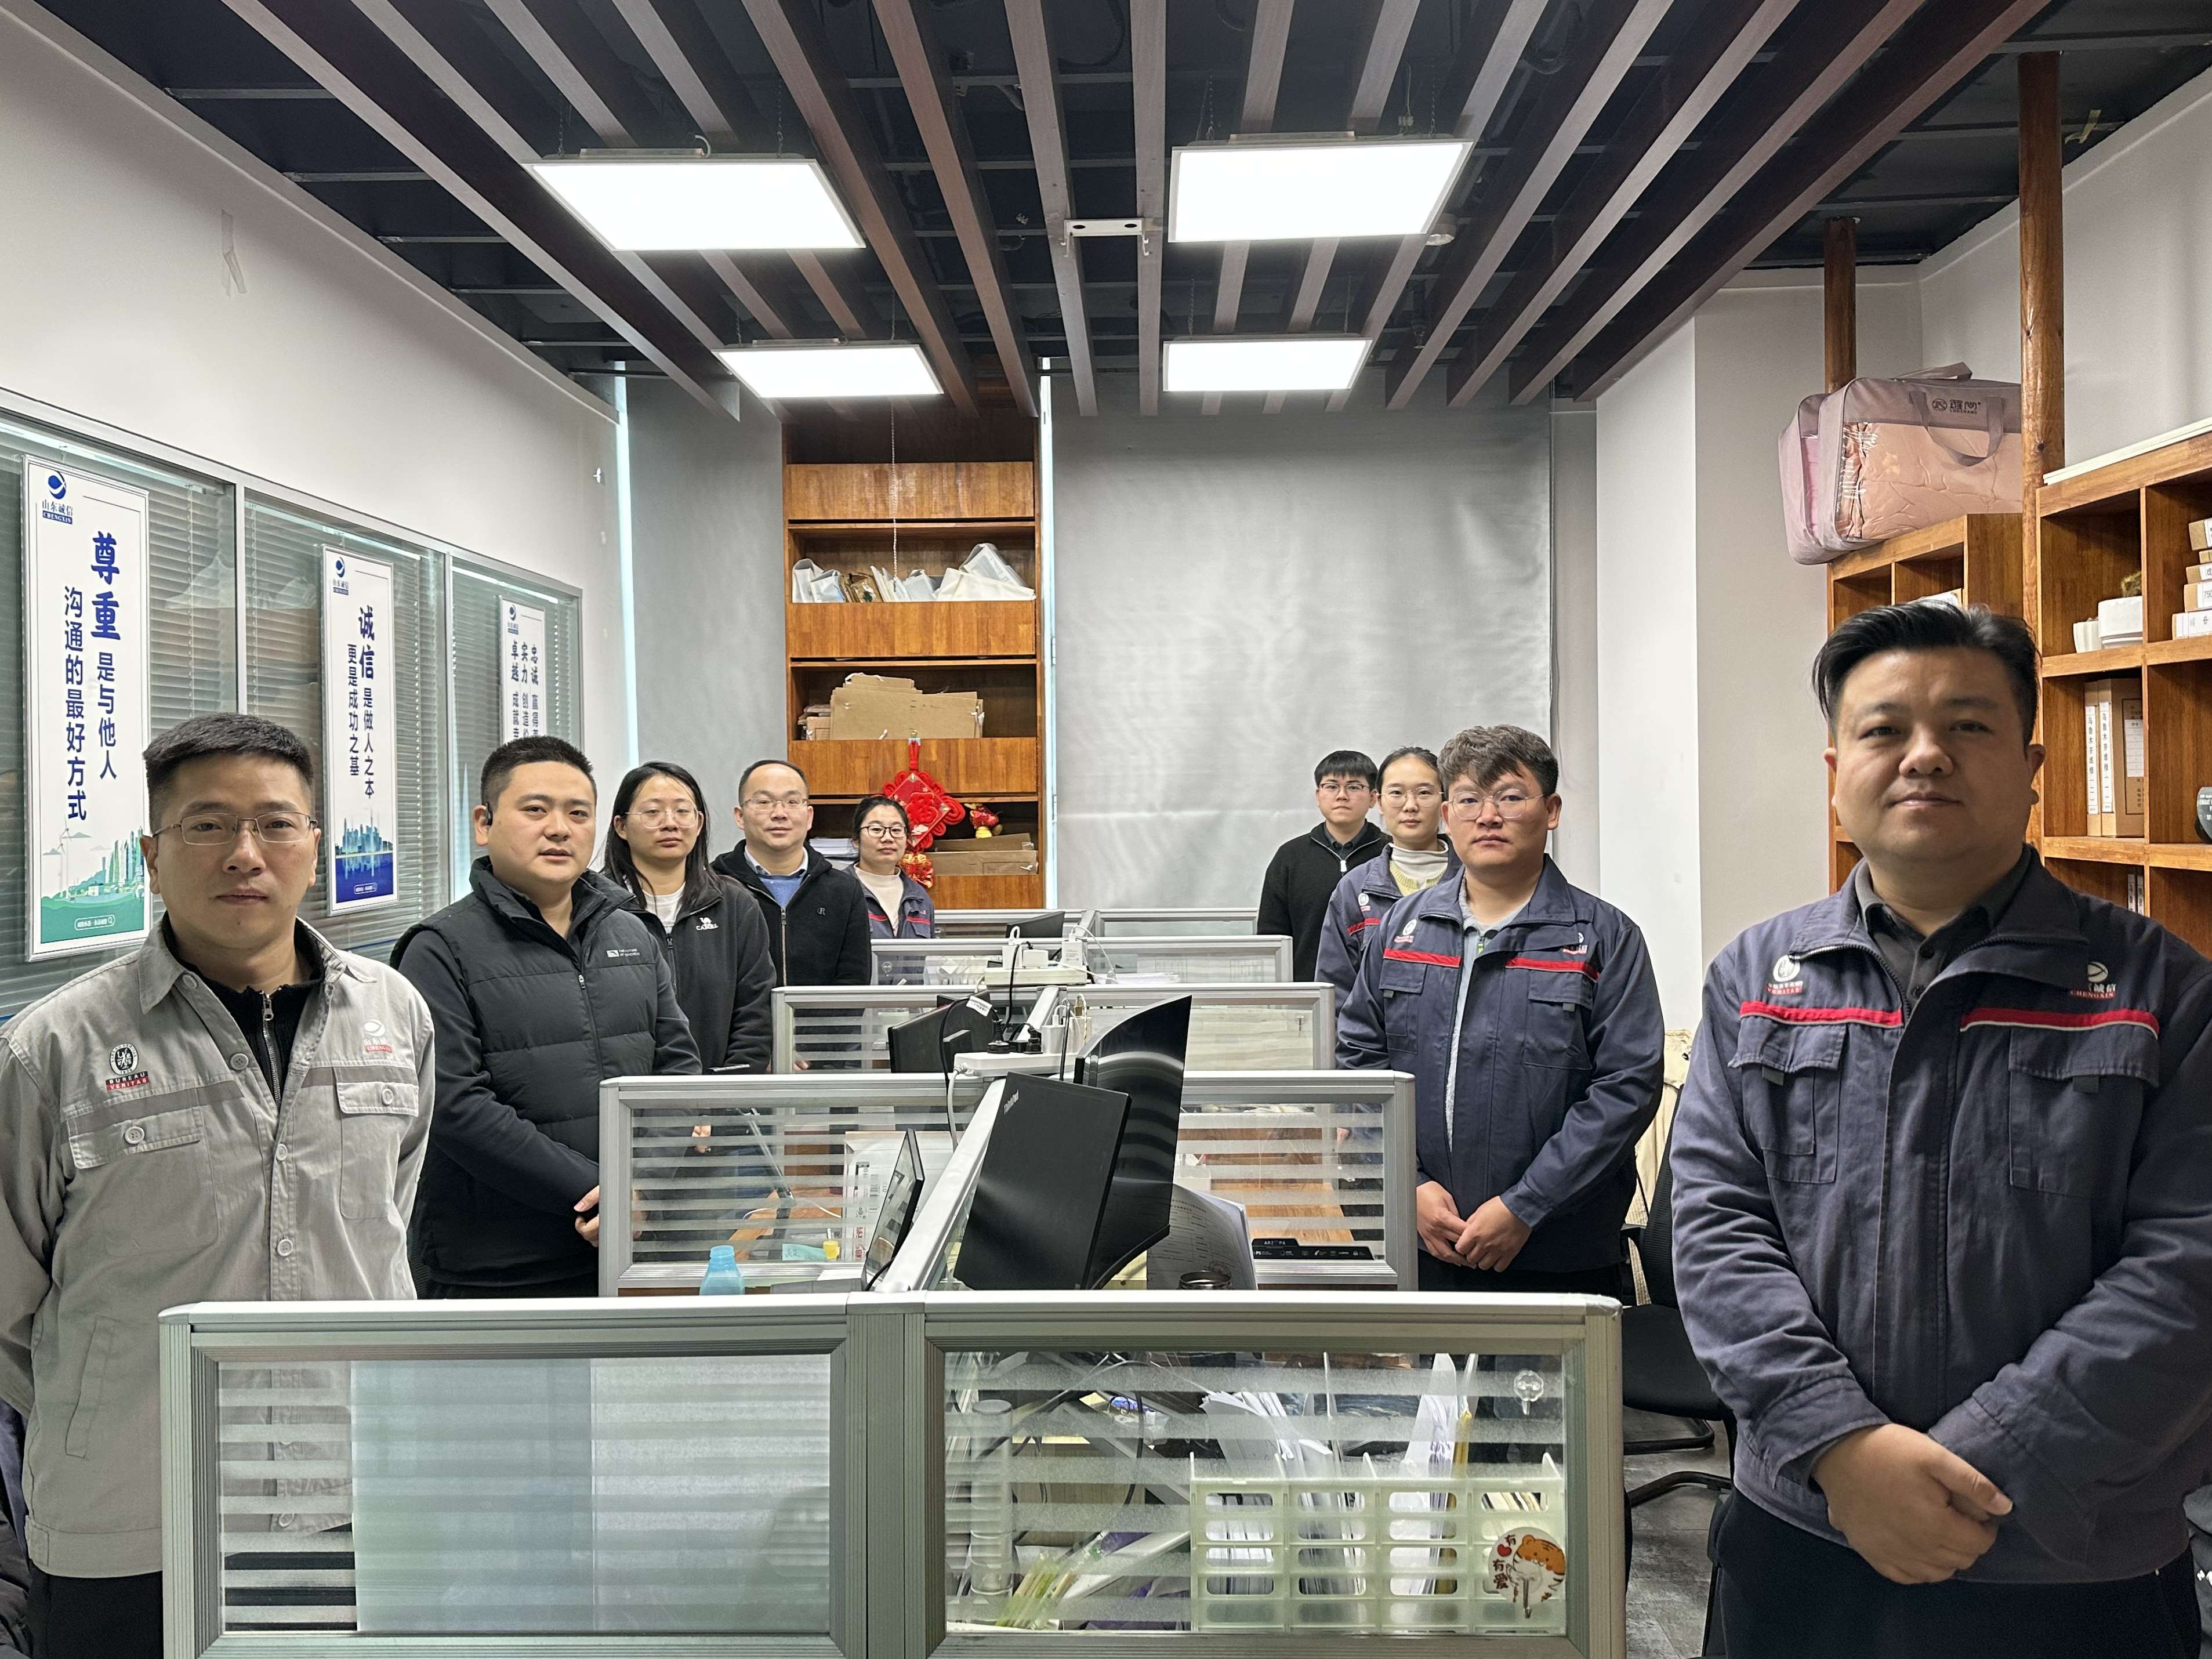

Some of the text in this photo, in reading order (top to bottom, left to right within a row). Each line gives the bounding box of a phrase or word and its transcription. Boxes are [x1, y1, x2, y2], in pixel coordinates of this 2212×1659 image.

[64, 585, 87, 821] 沟通的最好方式
[90, 530, 121, 780] 尊重 是与他人
[347, 643, 360, 776] 更是成功之基
[358, 604, 375, 799] 诚信 是做人之本
[109, 1073, 145, 1084] BUREAU
[110, 1078, 147, 1089] VERITAS
